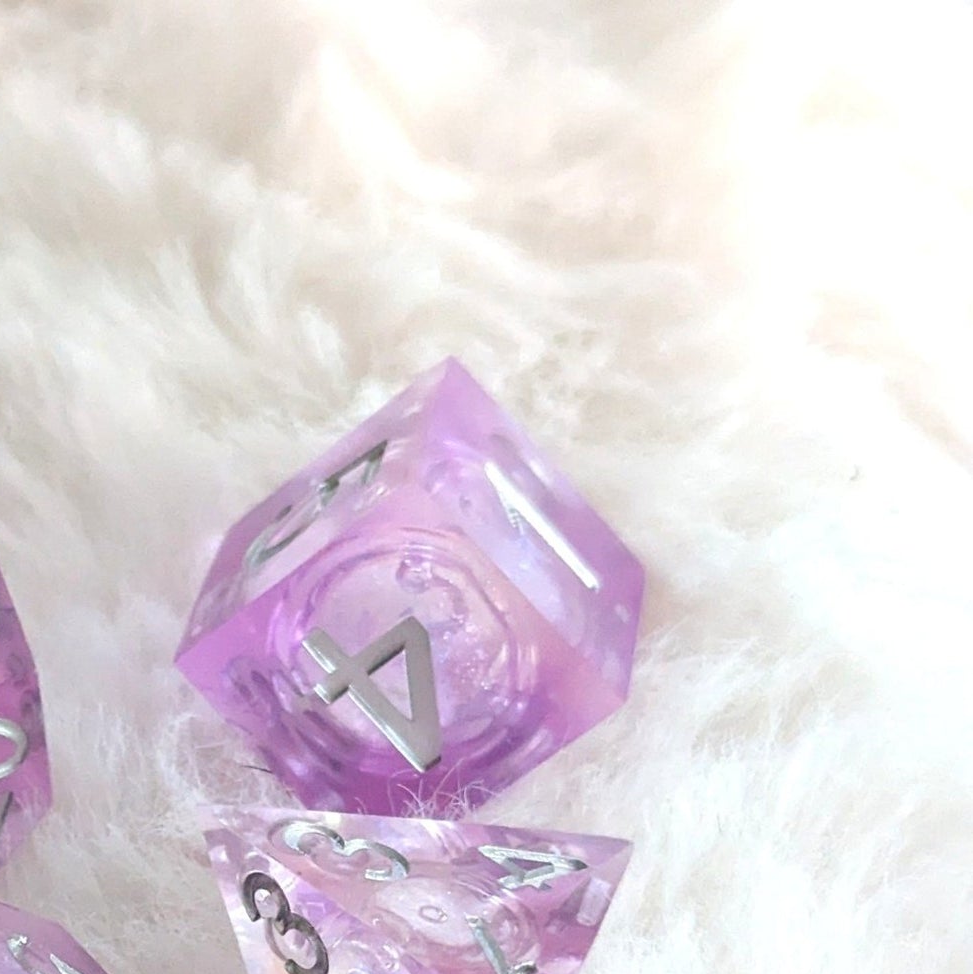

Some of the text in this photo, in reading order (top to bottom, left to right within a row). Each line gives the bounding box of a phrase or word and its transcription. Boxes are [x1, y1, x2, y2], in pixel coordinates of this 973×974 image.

[484, 460, 602, 592] 1
[300, 615, 442, 773] 4
[269, 822, 411, 882] 3
[478, 844, 589, 890] 4
